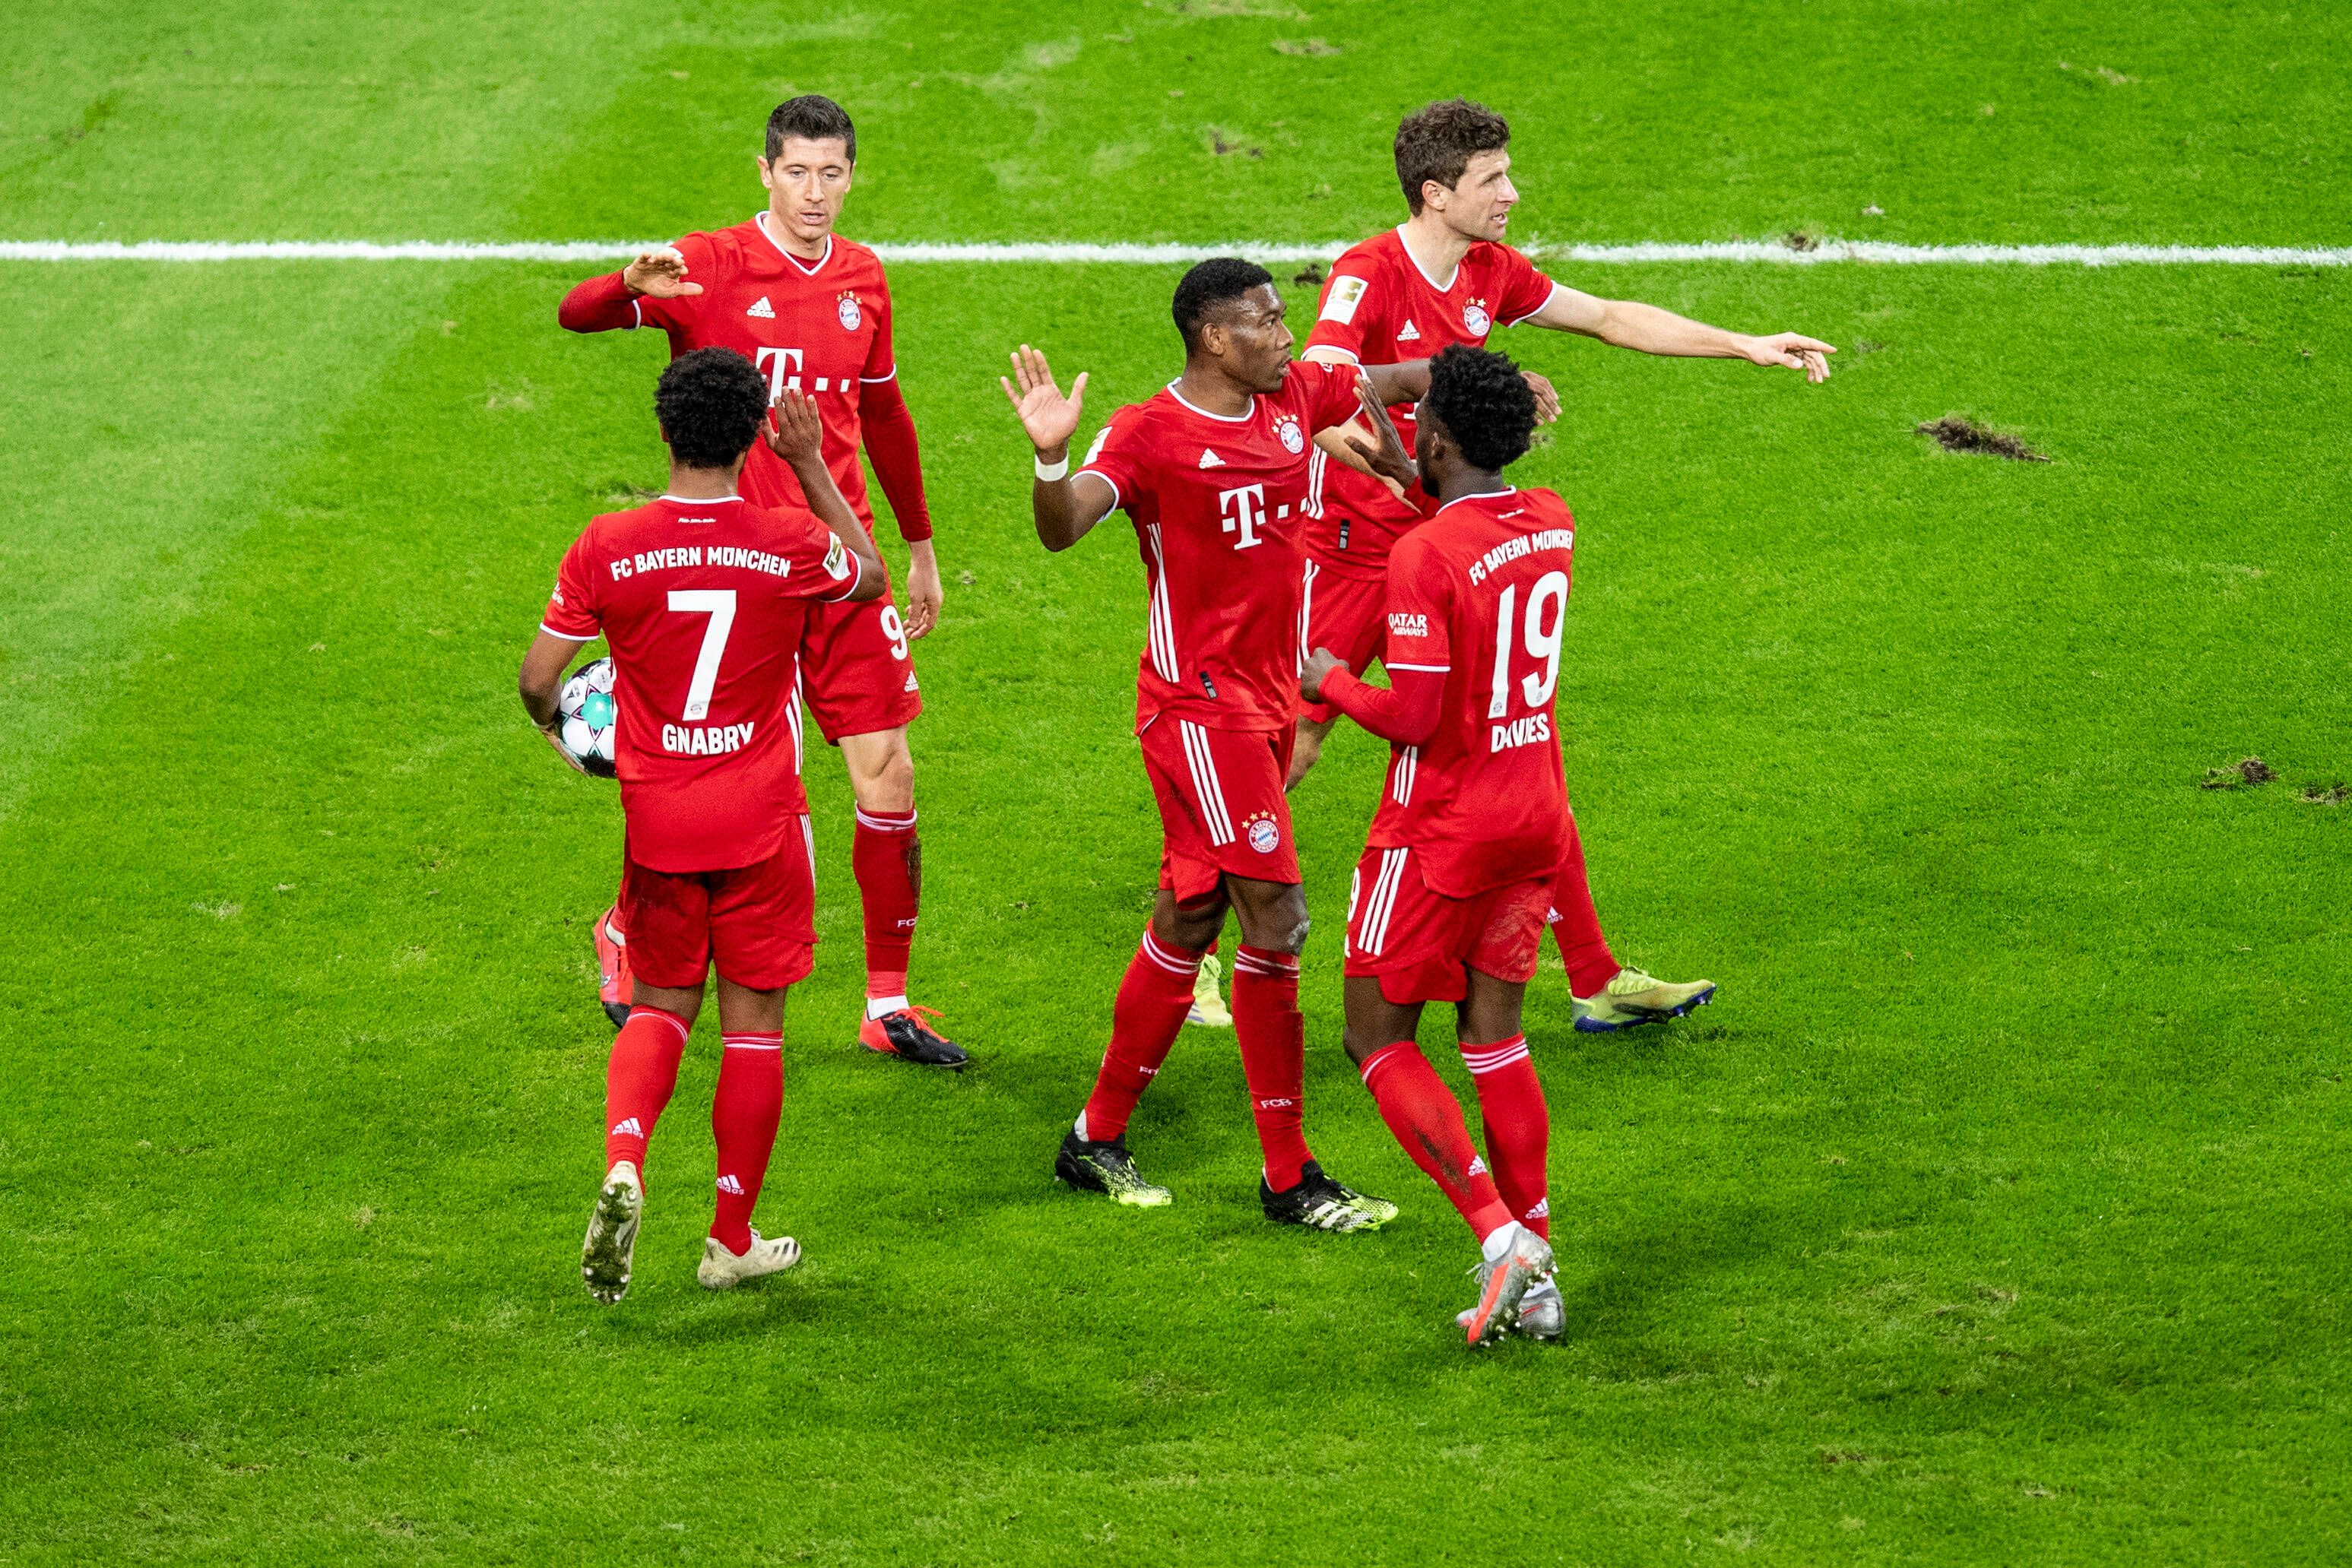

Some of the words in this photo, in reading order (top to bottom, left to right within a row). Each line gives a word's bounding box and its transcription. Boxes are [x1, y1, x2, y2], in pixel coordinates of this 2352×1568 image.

[610, 560, 632, 581] FC
[635, 546, 702, 574] BAYERN
[707, 546, 791, 579] MÜNCHEN
[1468, 561, 1487, 586] FC
[1482, 535, 1531, 573] BAYERN
[880, 605, 908, 660] 9
[1388, 613, 1427, 629] QATAR
[667, 589, 737, 721] 7
[1486, 571, 1569, 719] 19
[662, 721, 755, 755] GNABRY
[1491, 712, 1550, 753] DAVIES
[1260, 1098, 1292, 1109] FCB
[612, 1127, 644, 1139] adidas
